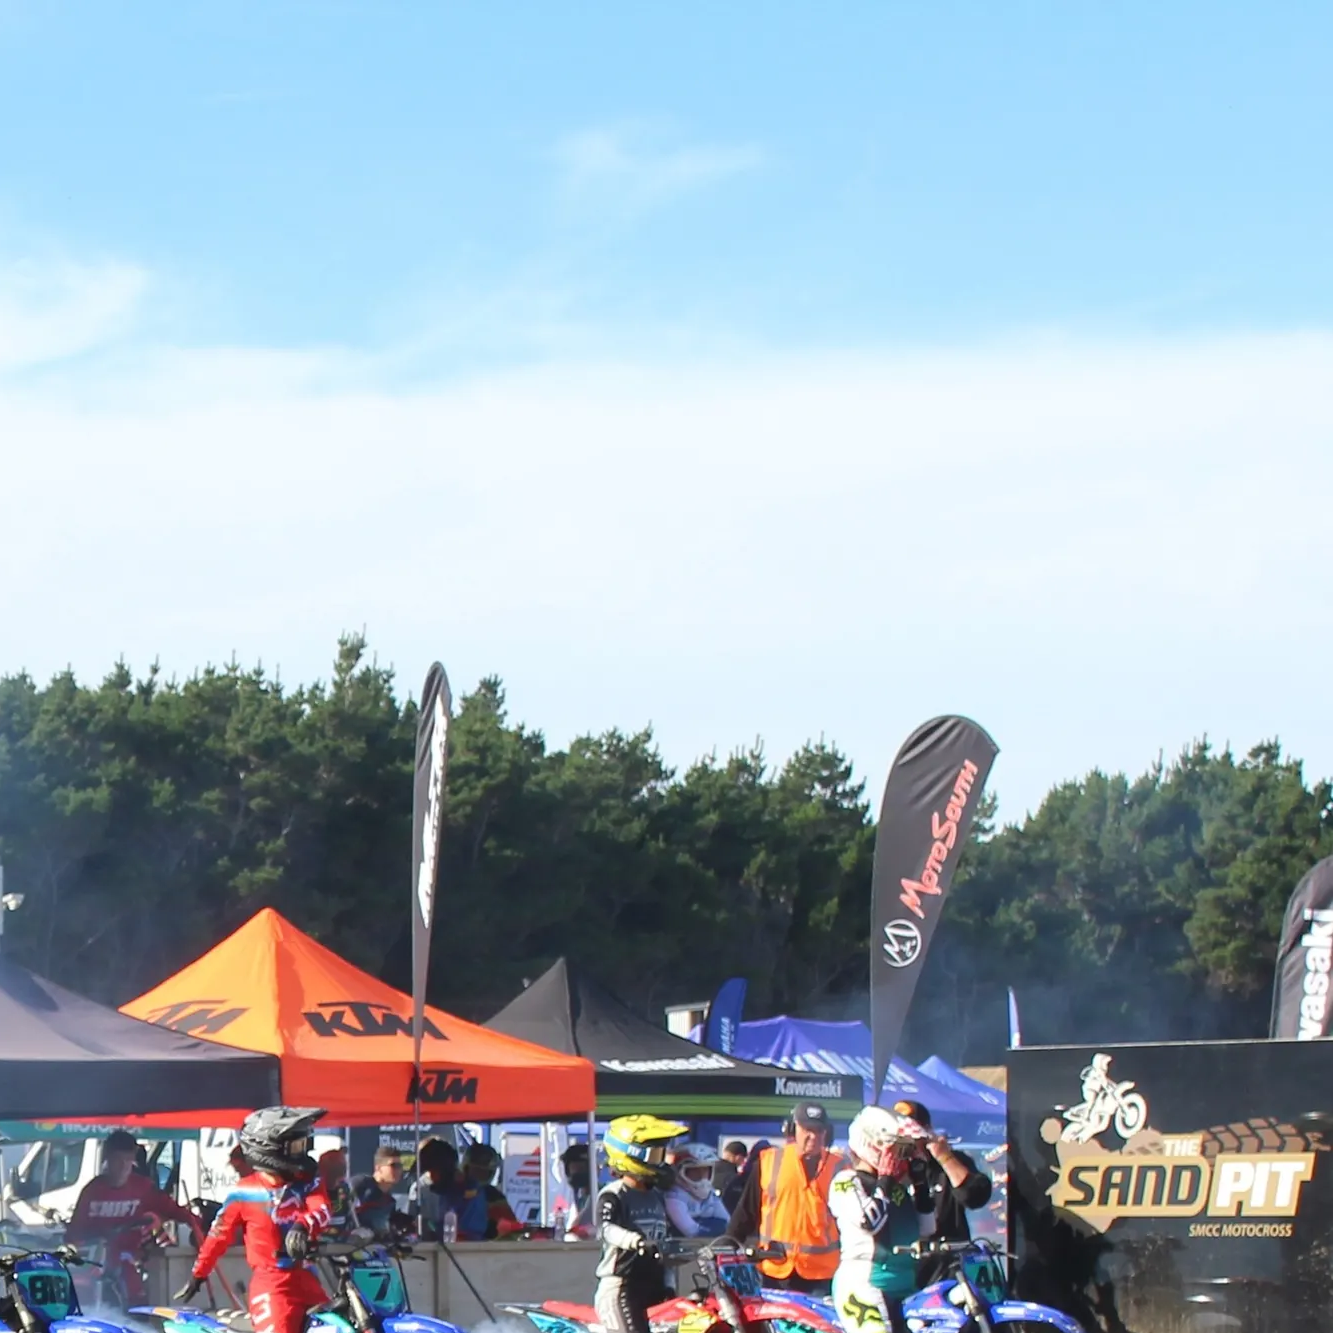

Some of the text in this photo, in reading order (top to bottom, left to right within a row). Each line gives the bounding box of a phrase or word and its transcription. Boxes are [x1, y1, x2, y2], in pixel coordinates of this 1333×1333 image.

[1298, 908, 1333, 1041] wasaki
[147, 999, 250, 1034] TM
[303, 1002, 450, 1041] KTM
[406, 1069, 478, 1103] KTM
[775, 1077, 842, 1098] Kawasaki
[1163, 1138, 1200, 1157] THE
[1064, 1164, 1203, 1207] SAND
[1215, 1161, 1306, 1208] PIT
[1189, 1223, 1293, 1238] SMCC MOTOCROSS
[369, 1272, 391, 1302] 7
